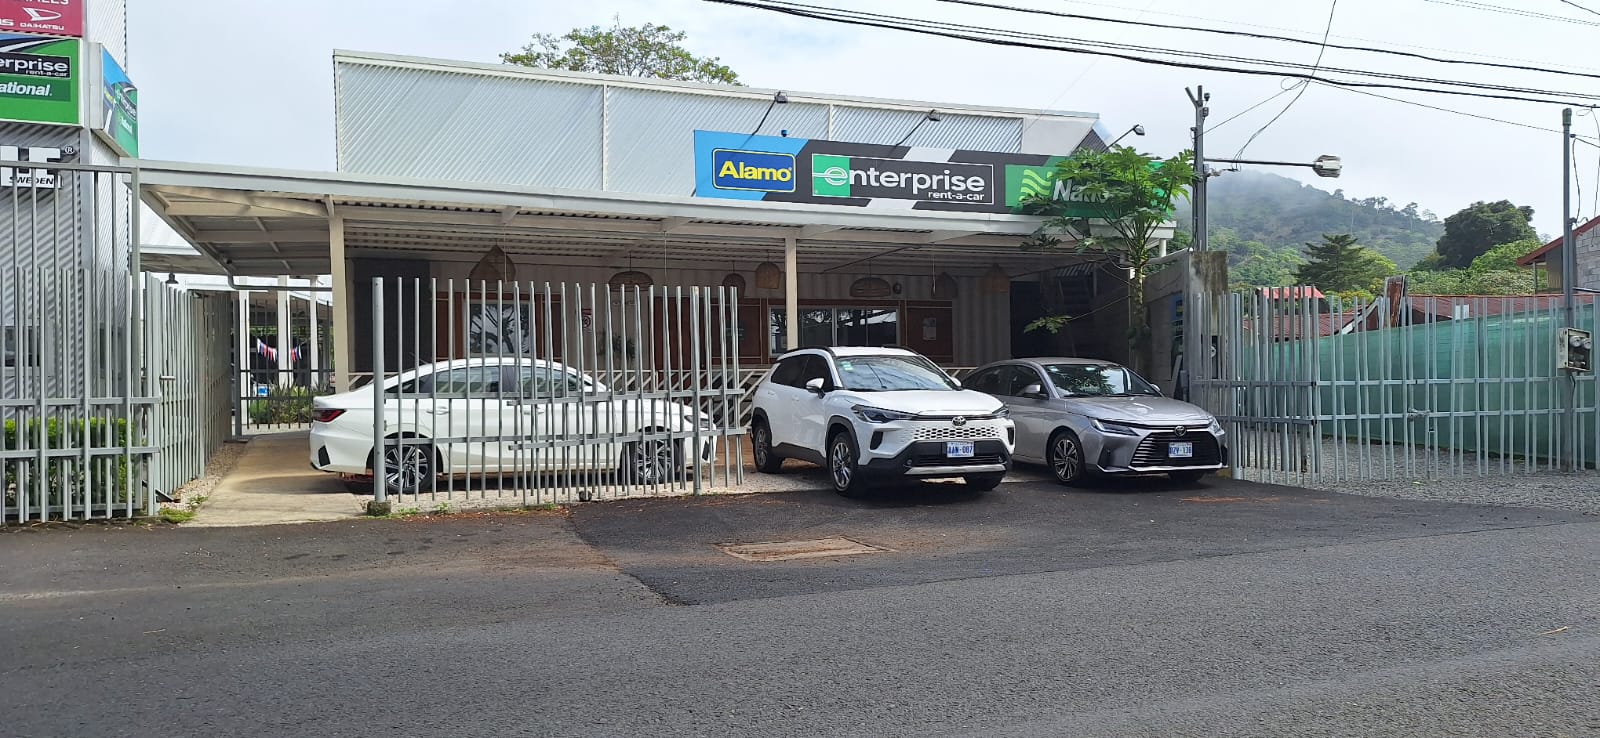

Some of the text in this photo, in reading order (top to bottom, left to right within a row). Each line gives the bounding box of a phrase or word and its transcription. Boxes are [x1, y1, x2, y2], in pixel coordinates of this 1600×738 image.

[20, 22, 65, 30] DAIHATSU
[719, 160, 792, 182] Alamo
[822, 167, 985, 194] enterprise
[928, 191, 984, 201] rent-a-car
